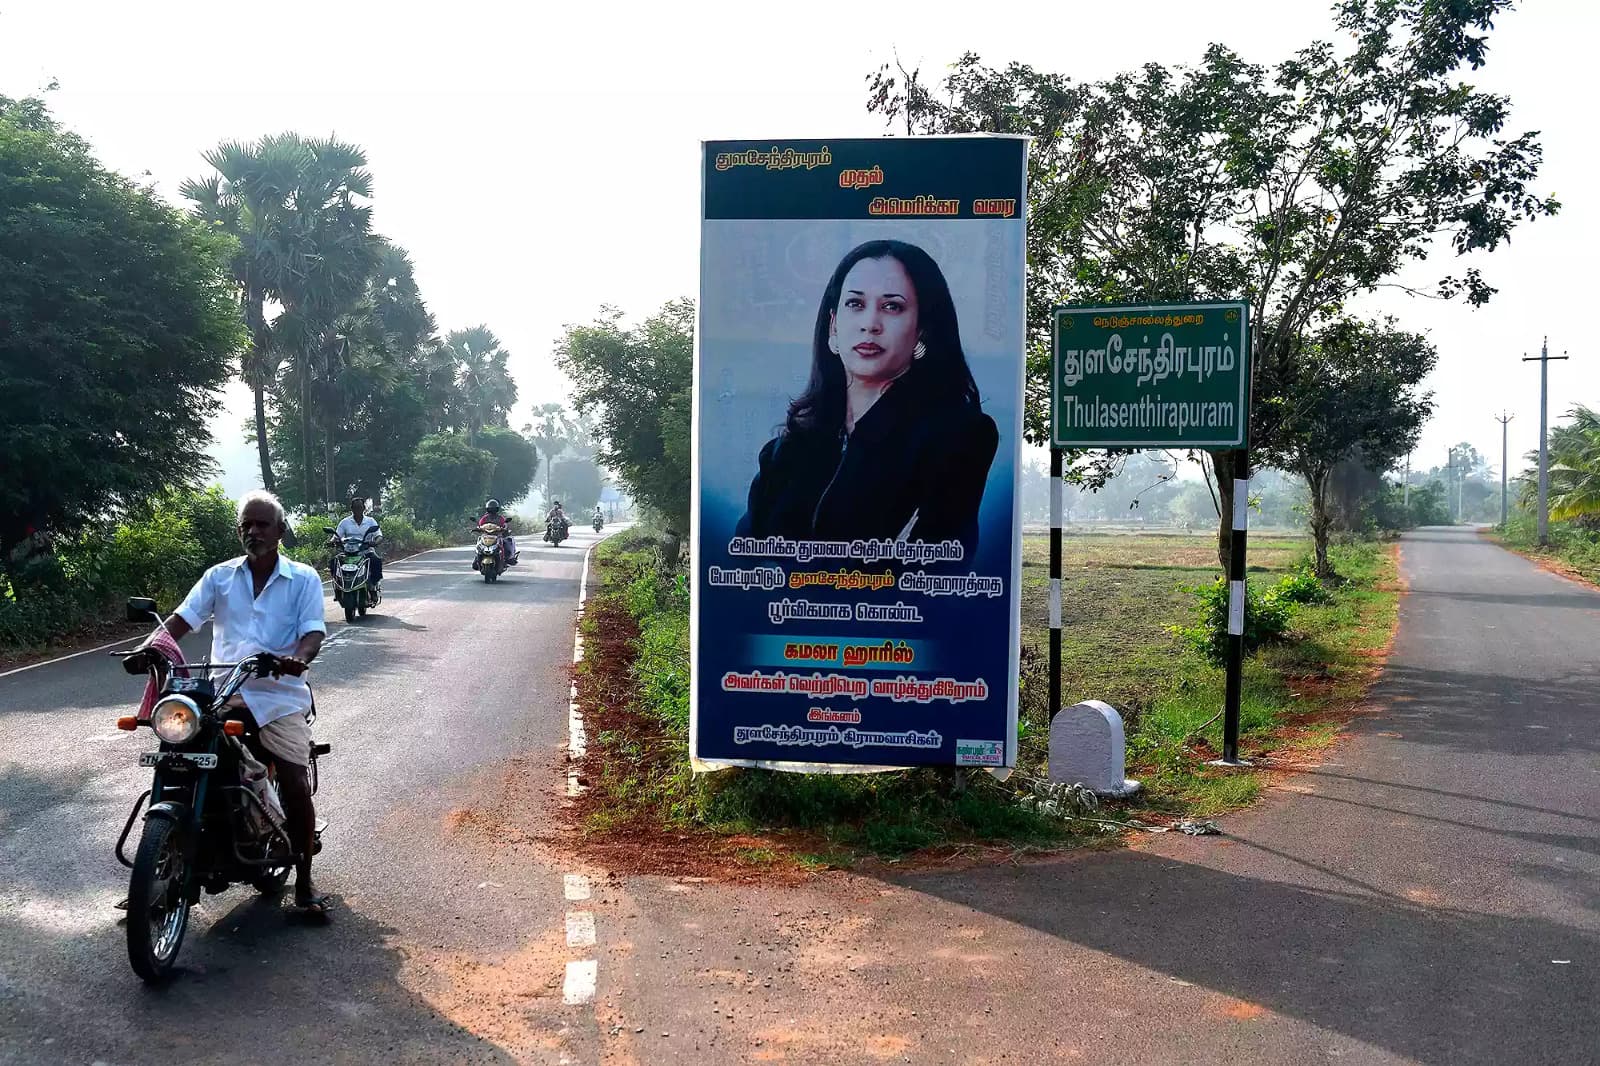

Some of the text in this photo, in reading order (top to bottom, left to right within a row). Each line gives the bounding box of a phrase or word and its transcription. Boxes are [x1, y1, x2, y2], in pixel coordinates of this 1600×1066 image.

[716, 146, 831, 170] துளசேந்திரபுரம்
[840, 165, 883, 189] முதல்
[869, 195, 1016, 217] அமெரிக்கா வரை
[1093, 313, 1204, 329] நெடுஞ்சாலைத்துறை
[1063, 332, 1235, 387] துளசேந்திரபுரம்
[1064, 394, 1233, 436] Thulasenthirapuram
[729, 536, 964, 565] அமெரிக்க துணை அதிபர் தேர்தலில்
[709, 566, 785, 590] போட்டியிடும்
[789, 568, 895, 590] துளசேந்திரபுரம்
[856, 601, 923, 622] கொண்ட
[784, 642, 839, 660] கமலா
[721, 669, 988, 704] அவர்கள் வெற்றிபெற வாழ்த்துகிறோம்
[734, 724, 942, 749] துளசேந்திரபுரம் கிராமவாசிகள்
